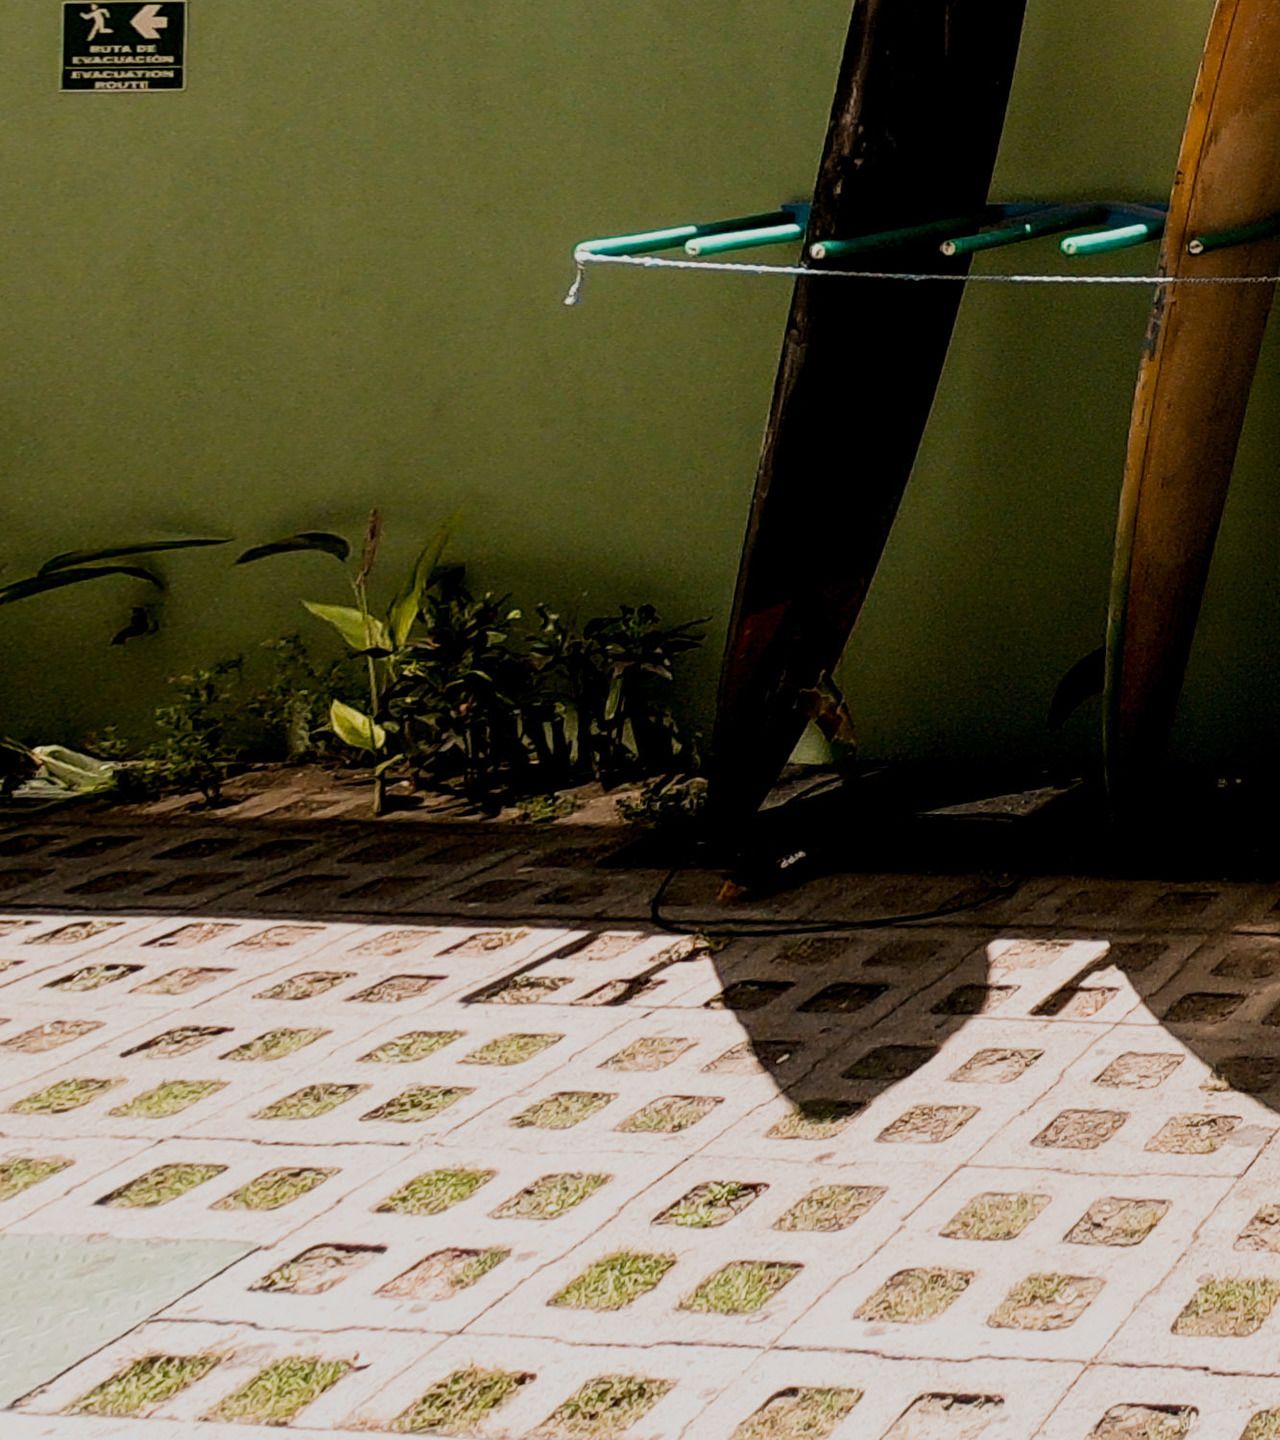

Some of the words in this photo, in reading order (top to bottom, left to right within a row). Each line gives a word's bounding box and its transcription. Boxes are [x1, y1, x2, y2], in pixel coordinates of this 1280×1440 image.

[89, 44, 132, 53] RUTA
[136, 44, 157, 53] DE
[70, 70, 175, 79] EVACUATION
